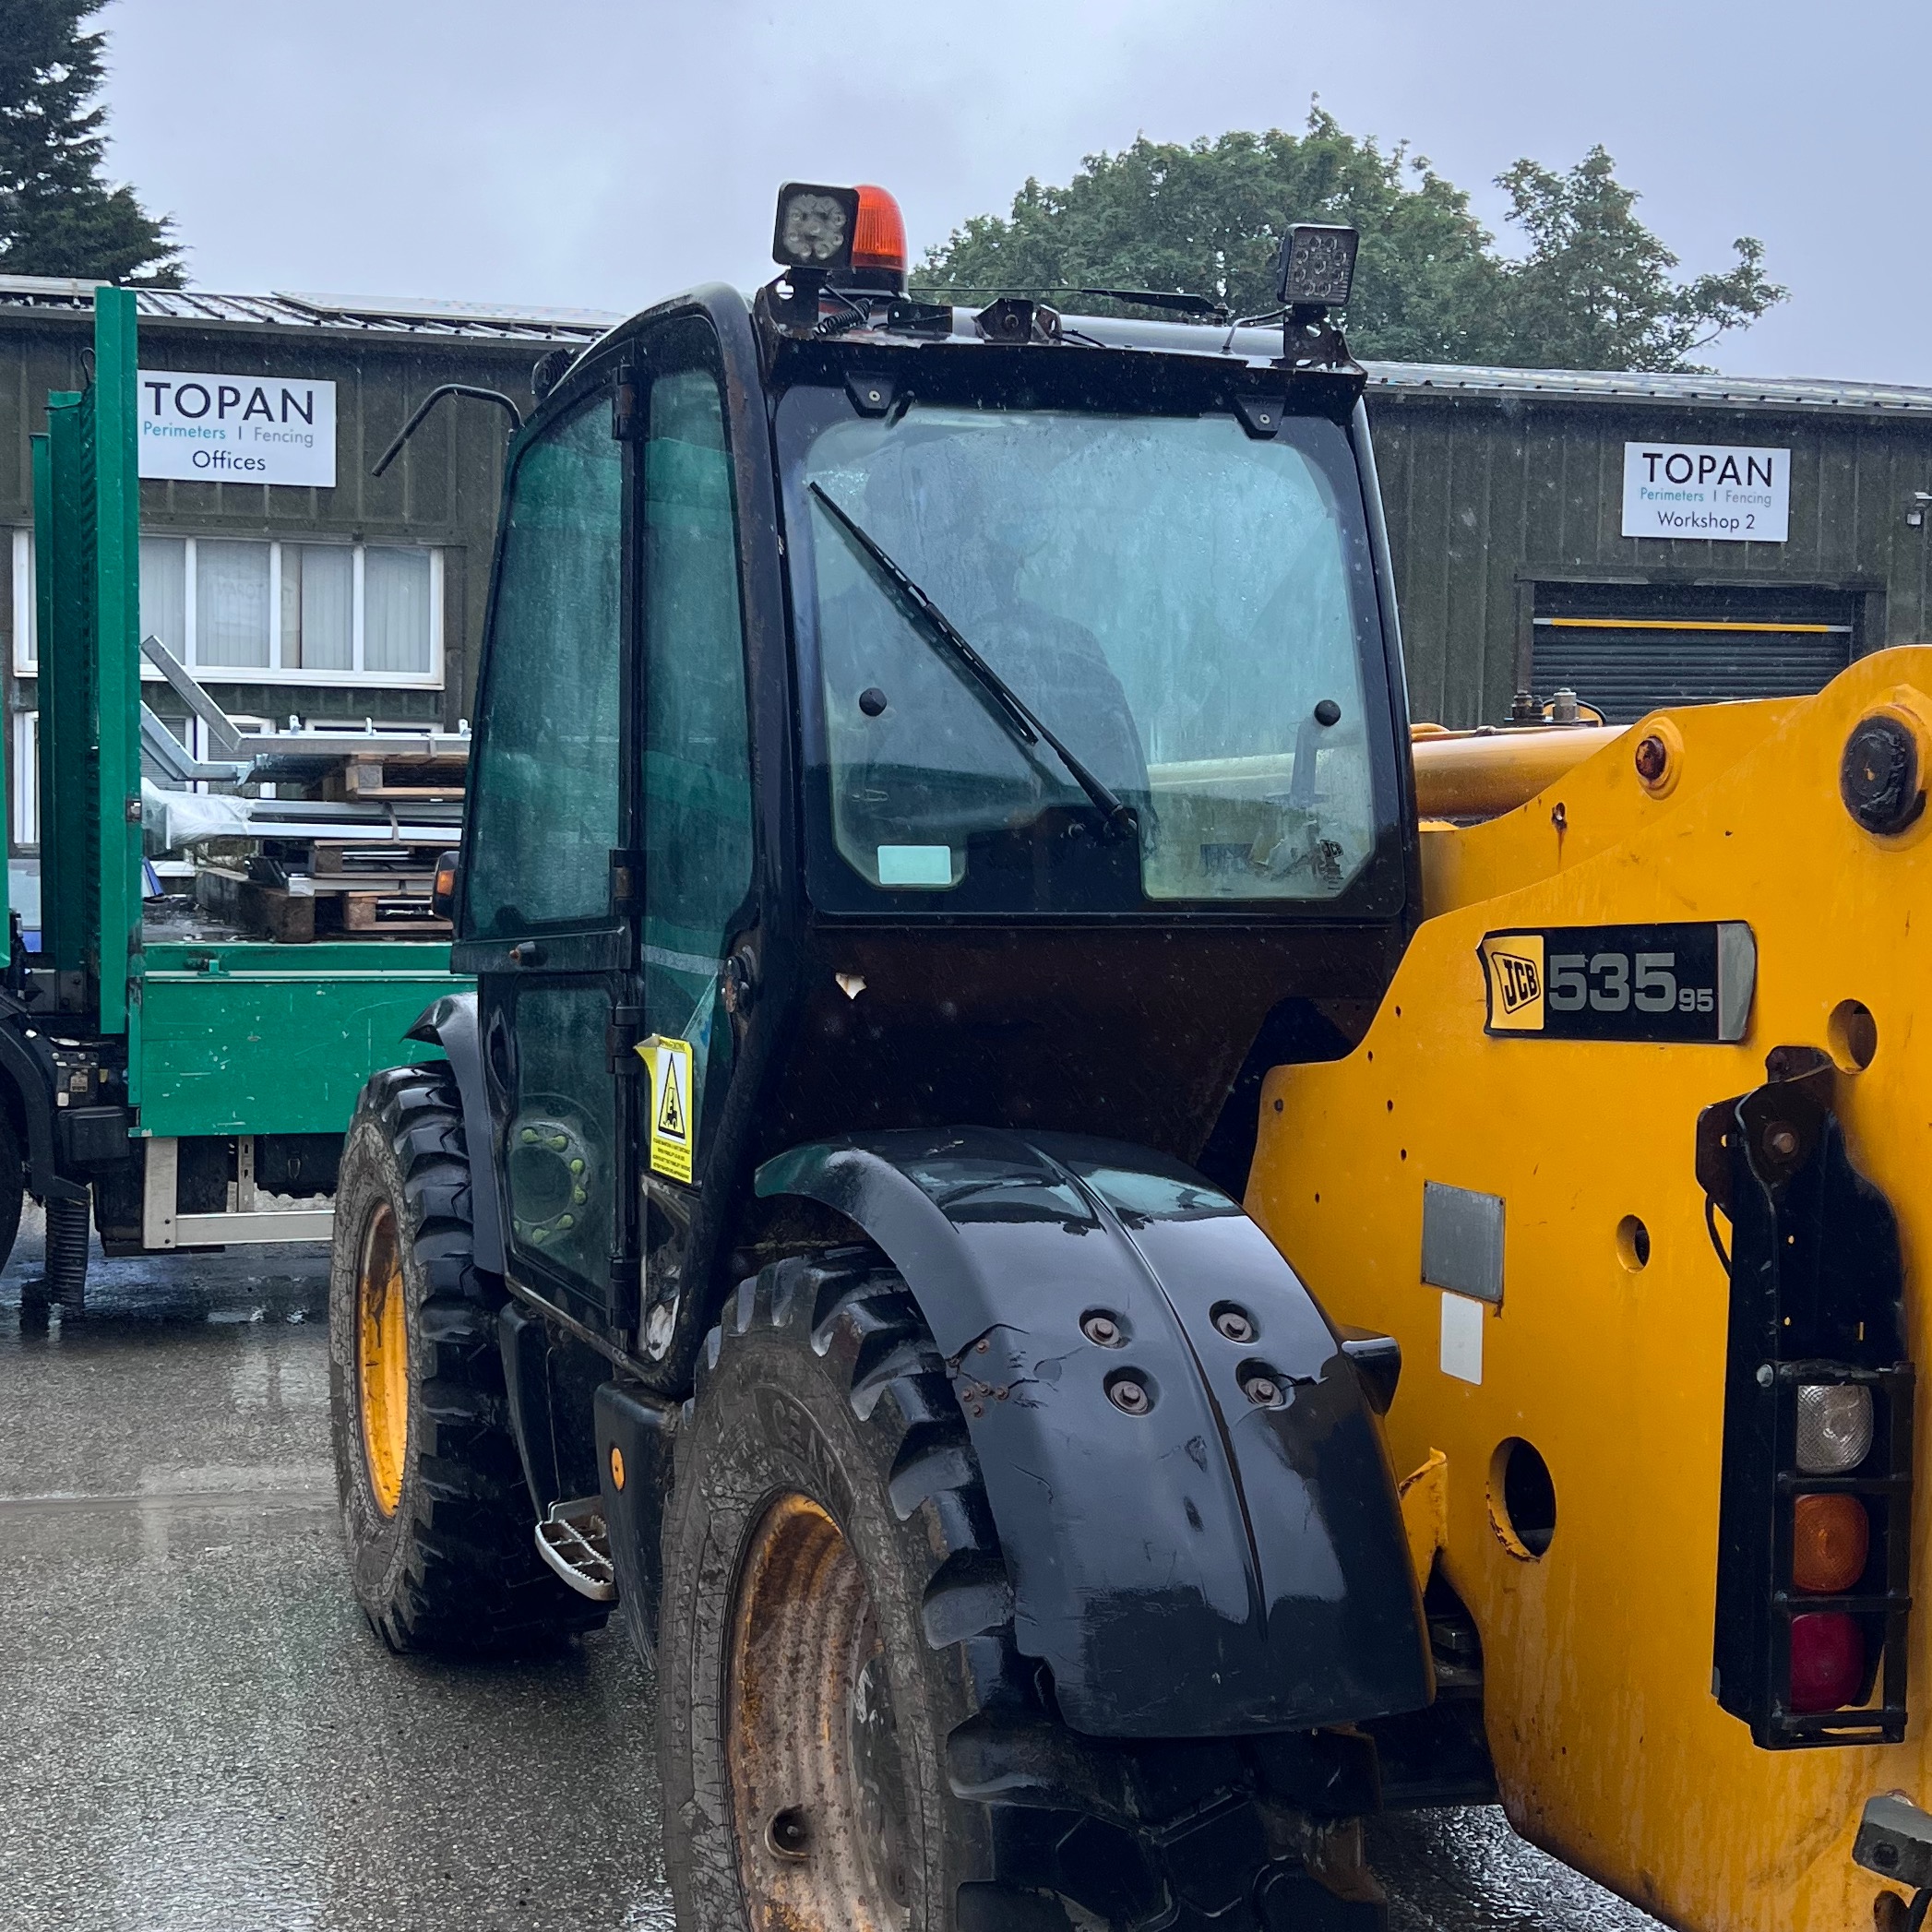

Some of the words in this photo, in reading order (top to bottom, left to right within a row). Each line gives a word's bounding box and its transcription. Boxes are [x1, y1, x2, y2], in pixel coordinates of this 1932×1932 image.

[144, 381, 314, 425] TOPAN
[144, 421, 226, 440] Perimeters
[254, 427, 314, 448] Fencing
[192, 450, 267, 471] Offices
[1642, 452, 1772, 487] TOPAN
[1640, 487, 1704, 503] Perimeters
[1725, 490, 1772, 507] Fencing
[1657, 511, 1740, 533] Workshop
[1746, 514, 1756, 530] 2
[1503, 958, 1539, 1008] JCB
[1548, 952, 1677, 1012] 535
[1678, 988, 1714, 1012] 95
